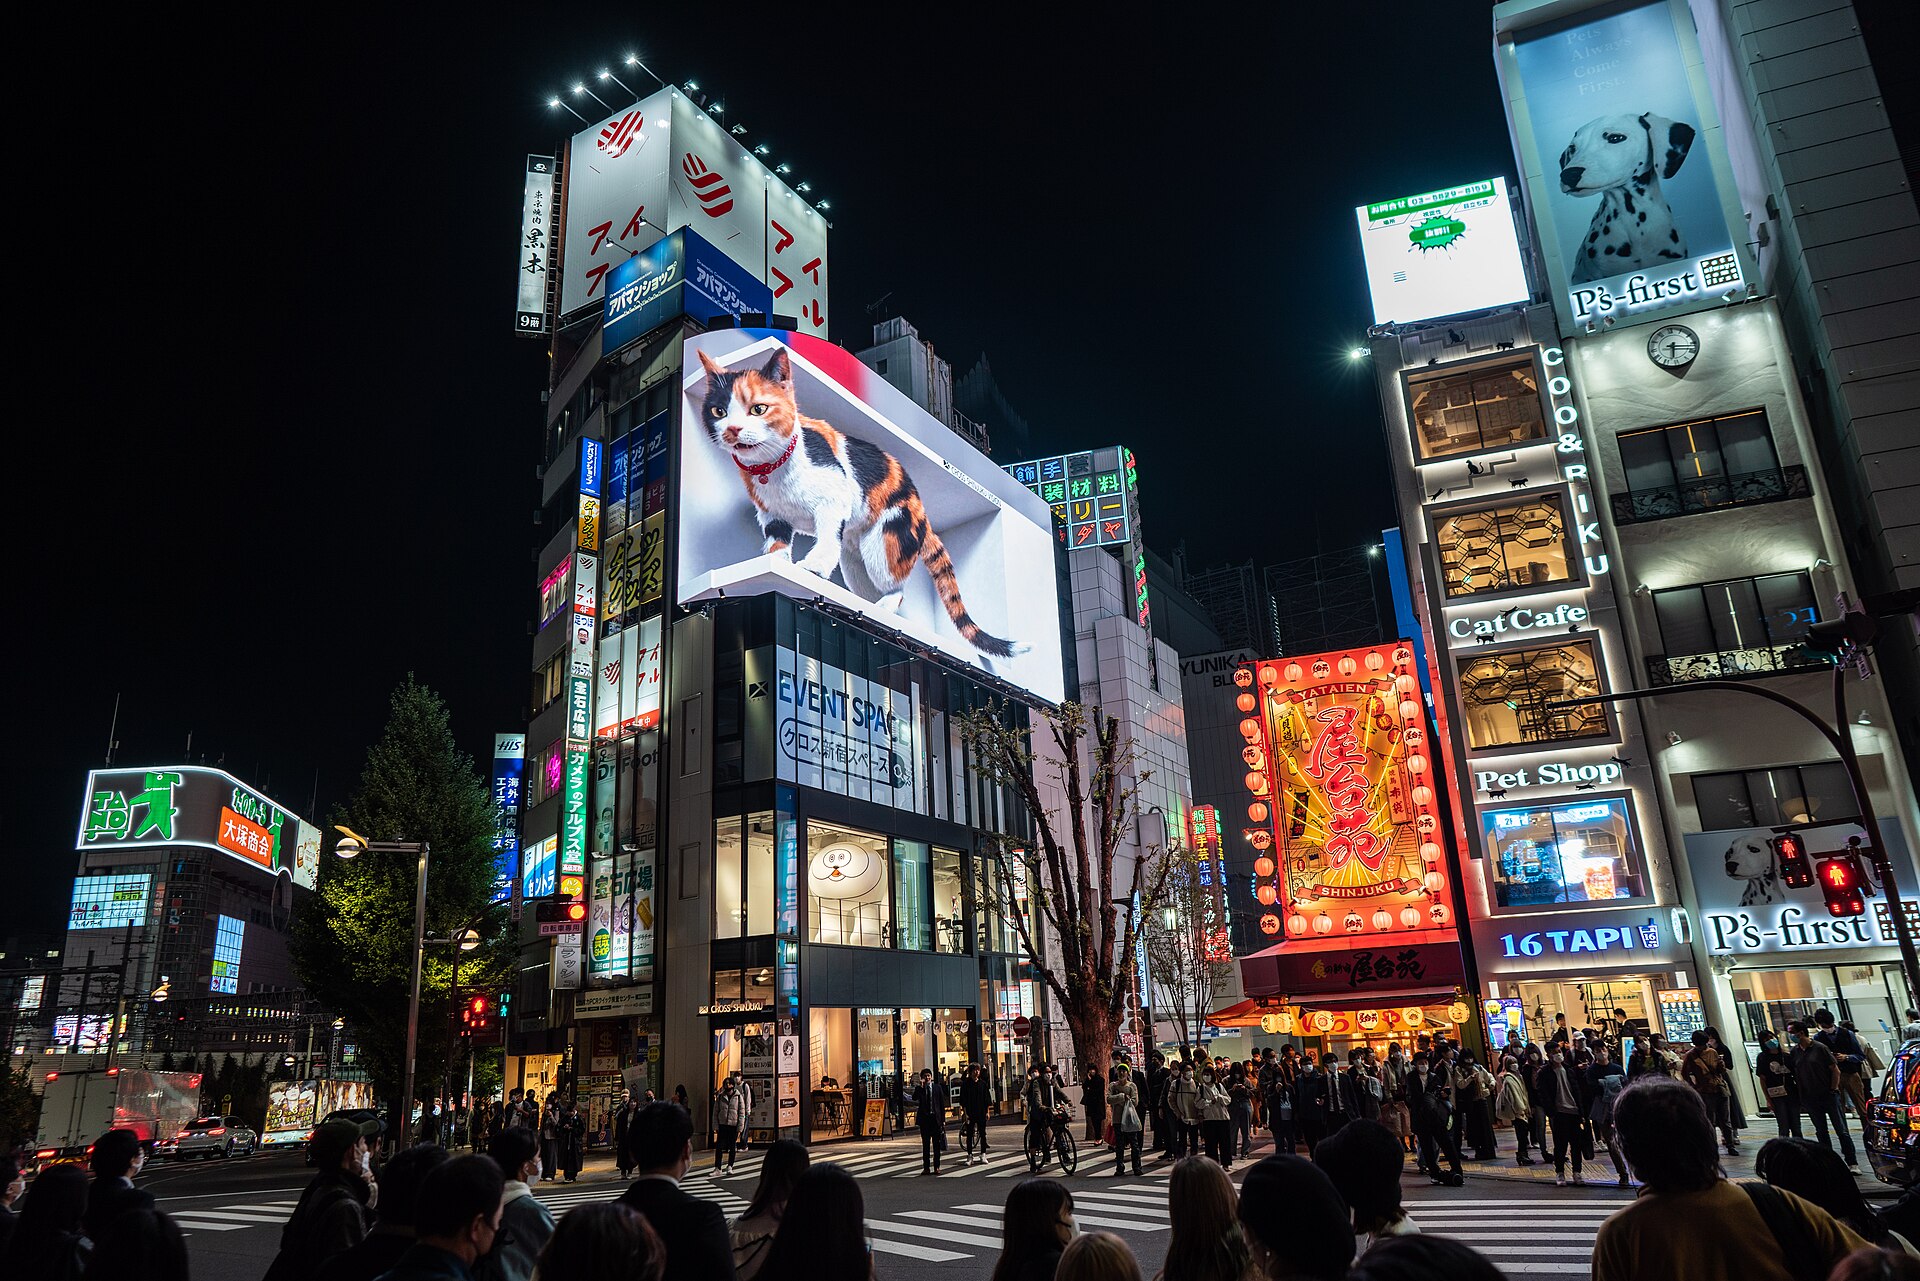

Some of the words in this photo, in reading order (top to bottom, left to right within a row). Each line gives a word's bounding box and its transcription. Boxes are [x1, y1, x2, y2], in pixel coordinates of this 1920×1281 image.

[1566, 27, 1601, 45] Pets
[1571, 37, 1632, 62] Always
[1574, 57, 1620, 79] Come
[1578, 76, 1626, 96] First.
[608, 260, 678, 317] アパマンショップ
[520, 315, 540, 328] 9階
[576, 594, 594, 605] フル
[577, 583, 594, 594] アイ
[1450, 614, 1508, 638] Cat
[1510, 604, 1587, 630] Cafe
[1179, 652, 1251, 676] YUNIKA
[779, 669, 849, 722] EVENT
[1298, 682, 1368, 699] YATAIEN
[572, 680, 588, 738] 宝石広場
[500, 741, 522, 751] HIS
[783, 727, 889, 774] クロス新宿スペース
[1303, 705, 1391, 871] 屋台苑
[1475, 768, 1531, 792] Pet
[1538, 762, 1621, 785] Shop
[92, 792, 127, 810] TA
[566, 753, 585, 864] カメラのアルプス堂
[88, 810, 128, 831] NO
[504, 777, 519, 850] 海外・国内旅行
[223, 819, 269, 857] 大塚商会
[595, 864, 653, 900] 宝石広場
[1321, 881, 1395, 898] SHINJUKU
[1876, 903, 1918, 913] Pts
[1879, 913, 1920, 921] alys
[542, 923, 580, 933] 自転車専用
[1643, 932, 1656, 941] 16
[1500, 932, 1543, 958] 16
[1545, 926, 1634, 953] TAPI
[1349, 950, 1427, 987] 屋台苑
[710, 1005, 731, 1014] CROSS
[732, 1002, 763, 1012] SHINJUKU
